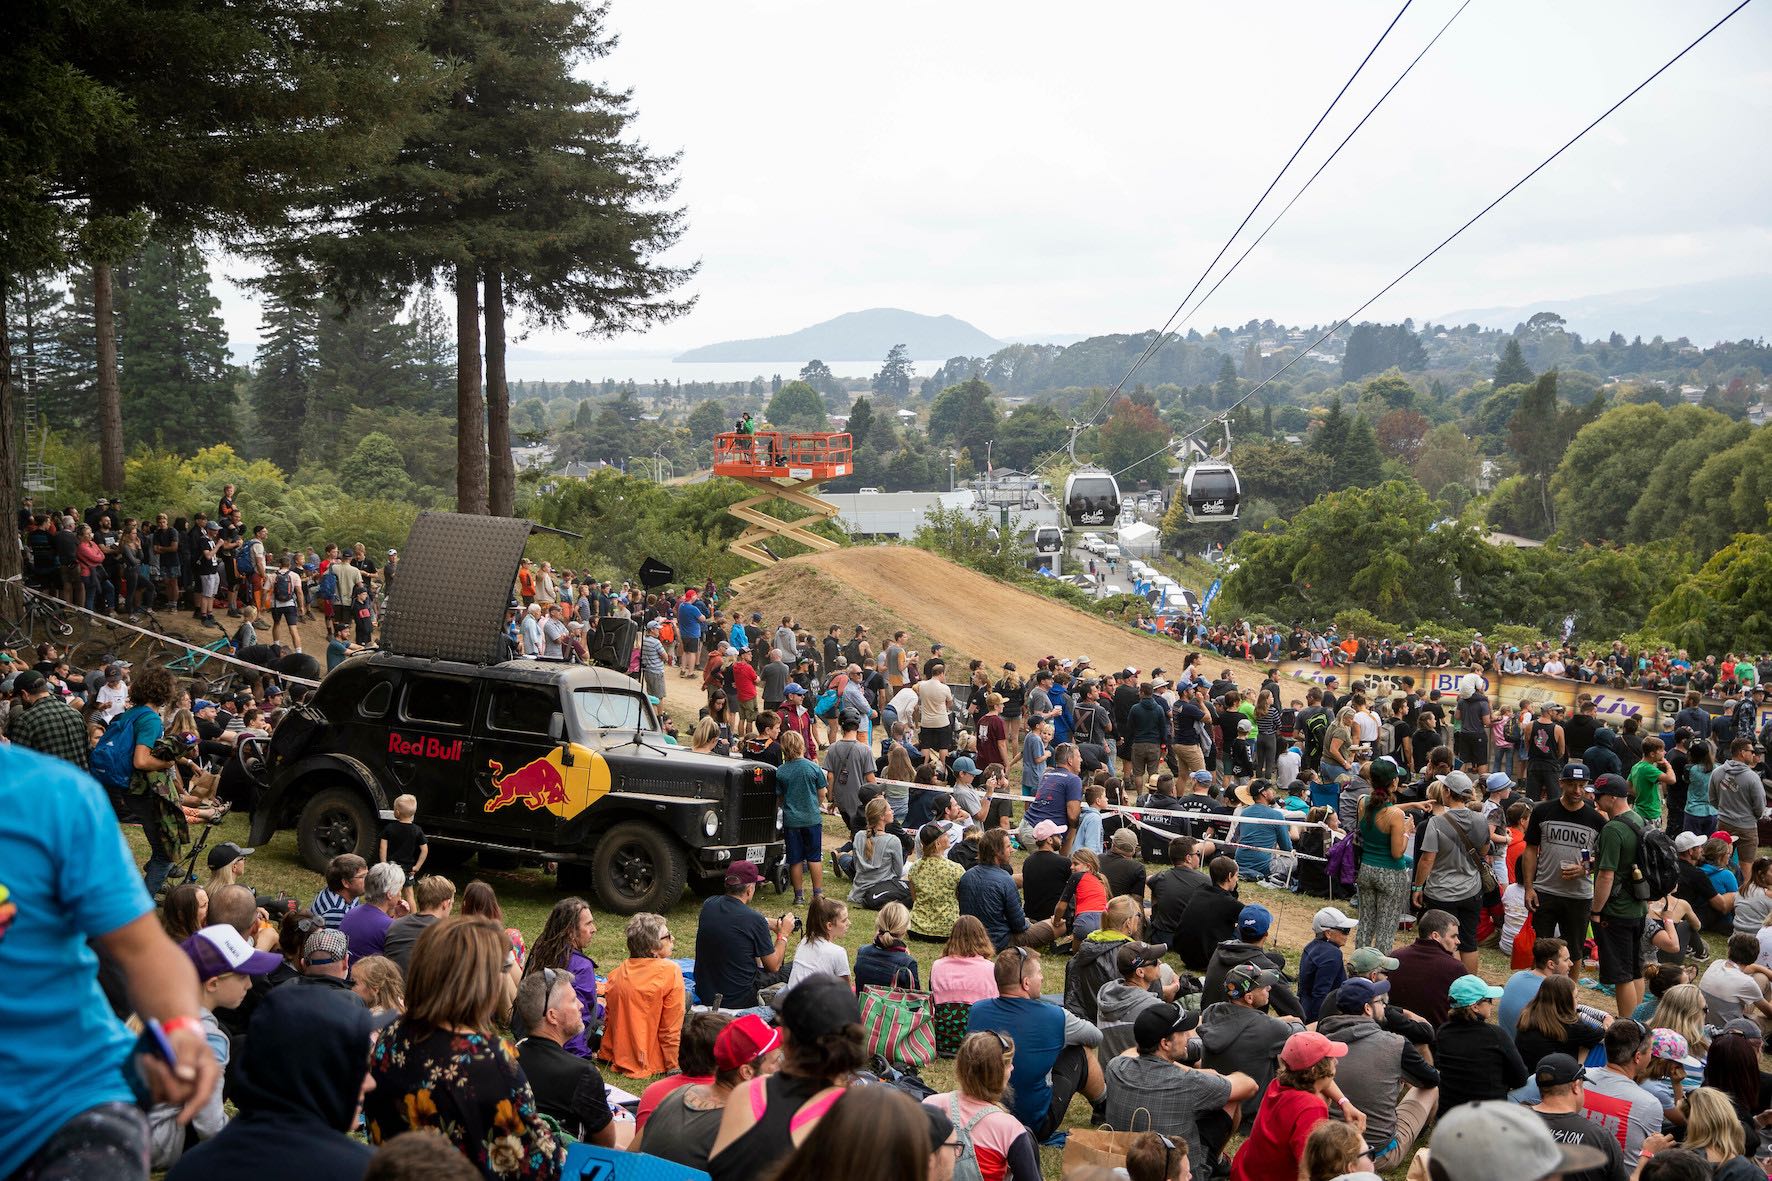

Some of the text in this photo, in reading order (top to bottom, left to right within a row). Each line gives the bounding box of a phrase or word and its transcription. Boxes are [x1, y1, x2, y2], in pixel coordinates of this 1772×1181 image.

[1593, 694, 1641, 717] Liv
[388, 732, 463, 761] Red Bull
[1550, 827, 1587, 845] MONS
